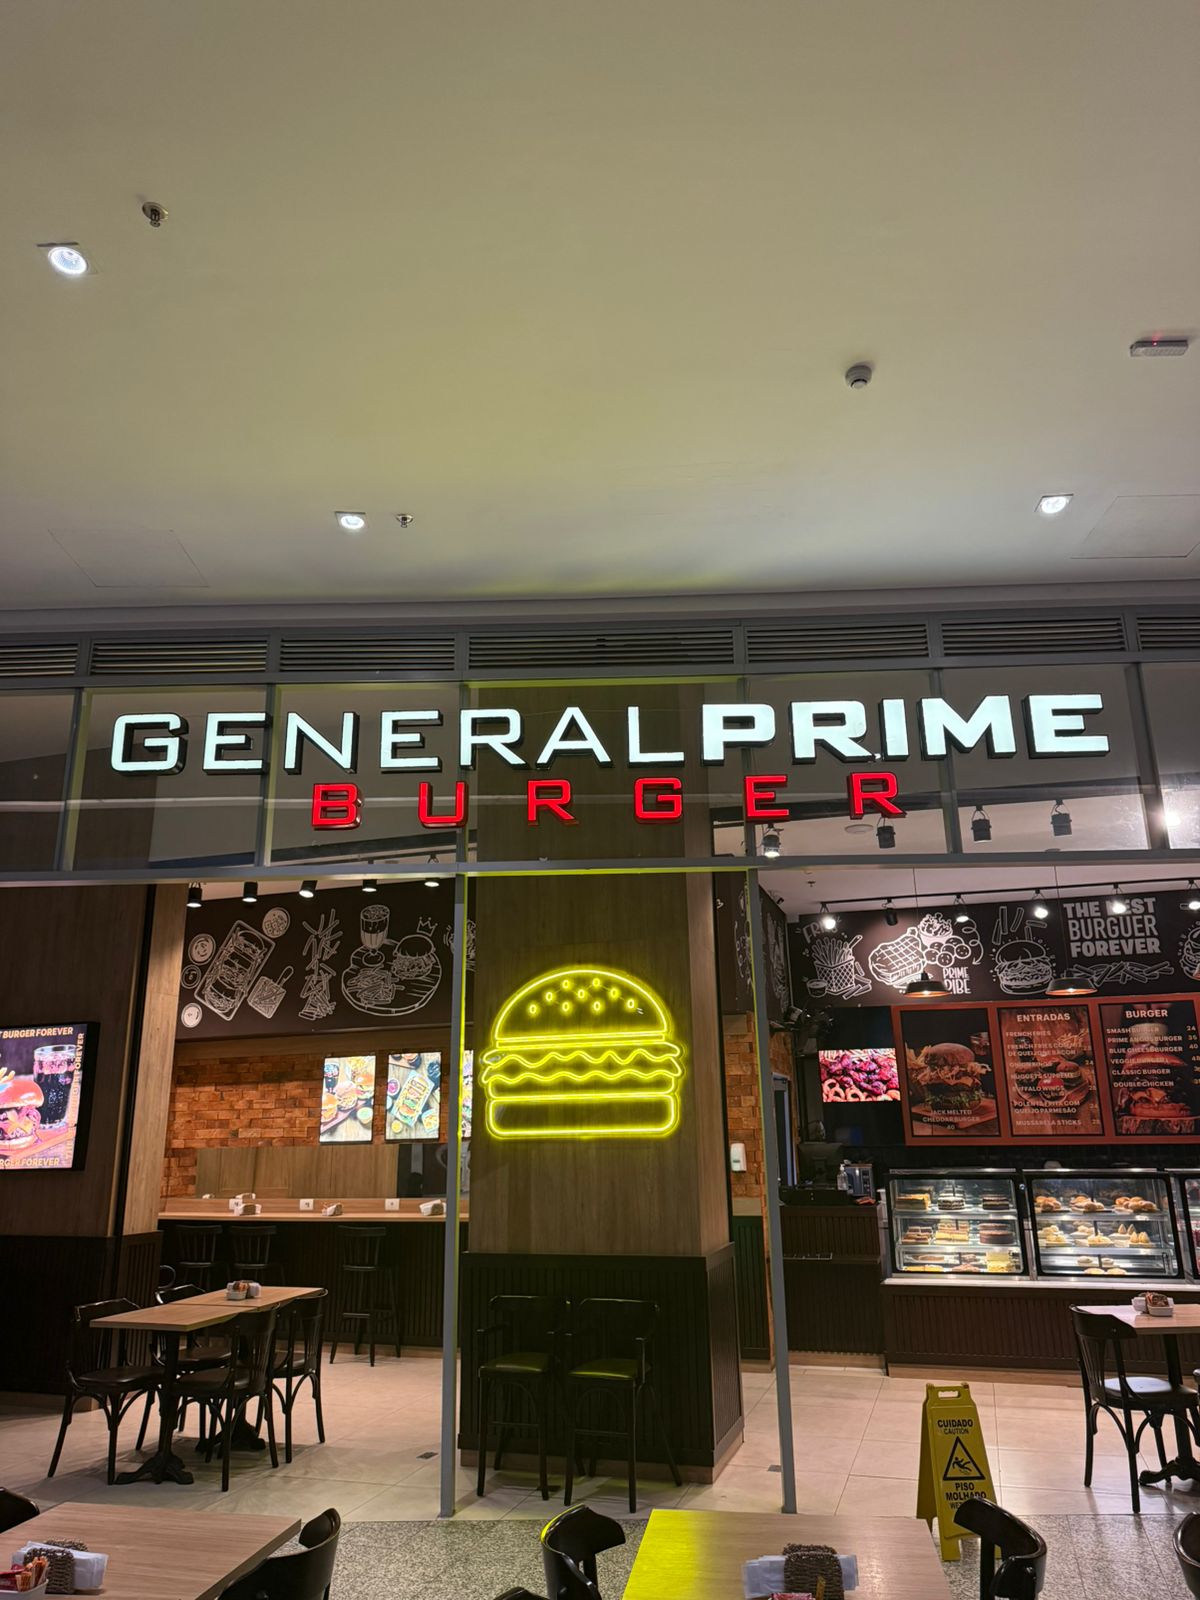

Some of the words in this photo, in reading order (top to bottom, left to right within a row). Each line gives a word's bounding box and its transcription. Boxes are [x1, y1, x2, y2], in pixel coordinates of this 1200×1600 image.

[312, 772, 905, 830] BURGER
[1063, 901, 1100, 918] THE
[1068, 915, 1158, 941] BURGUER
[1070, 938, 1161, 958] FOREVER
[943, 966, 969, 979] PRIME
[1016, 1013, 1071, 1022] ENTRADAS
[1125, 1009, 1168, 1018] BURGER
[2, 1029, 36, 1039] BURGER
[36, 1026, 74, 1037] FOREVER
[937, 1419, 974, 1428] CUIDADO
[943, 1427, 969, 1435] CAUTION
[955, 1482, 975, 1491] PISO
